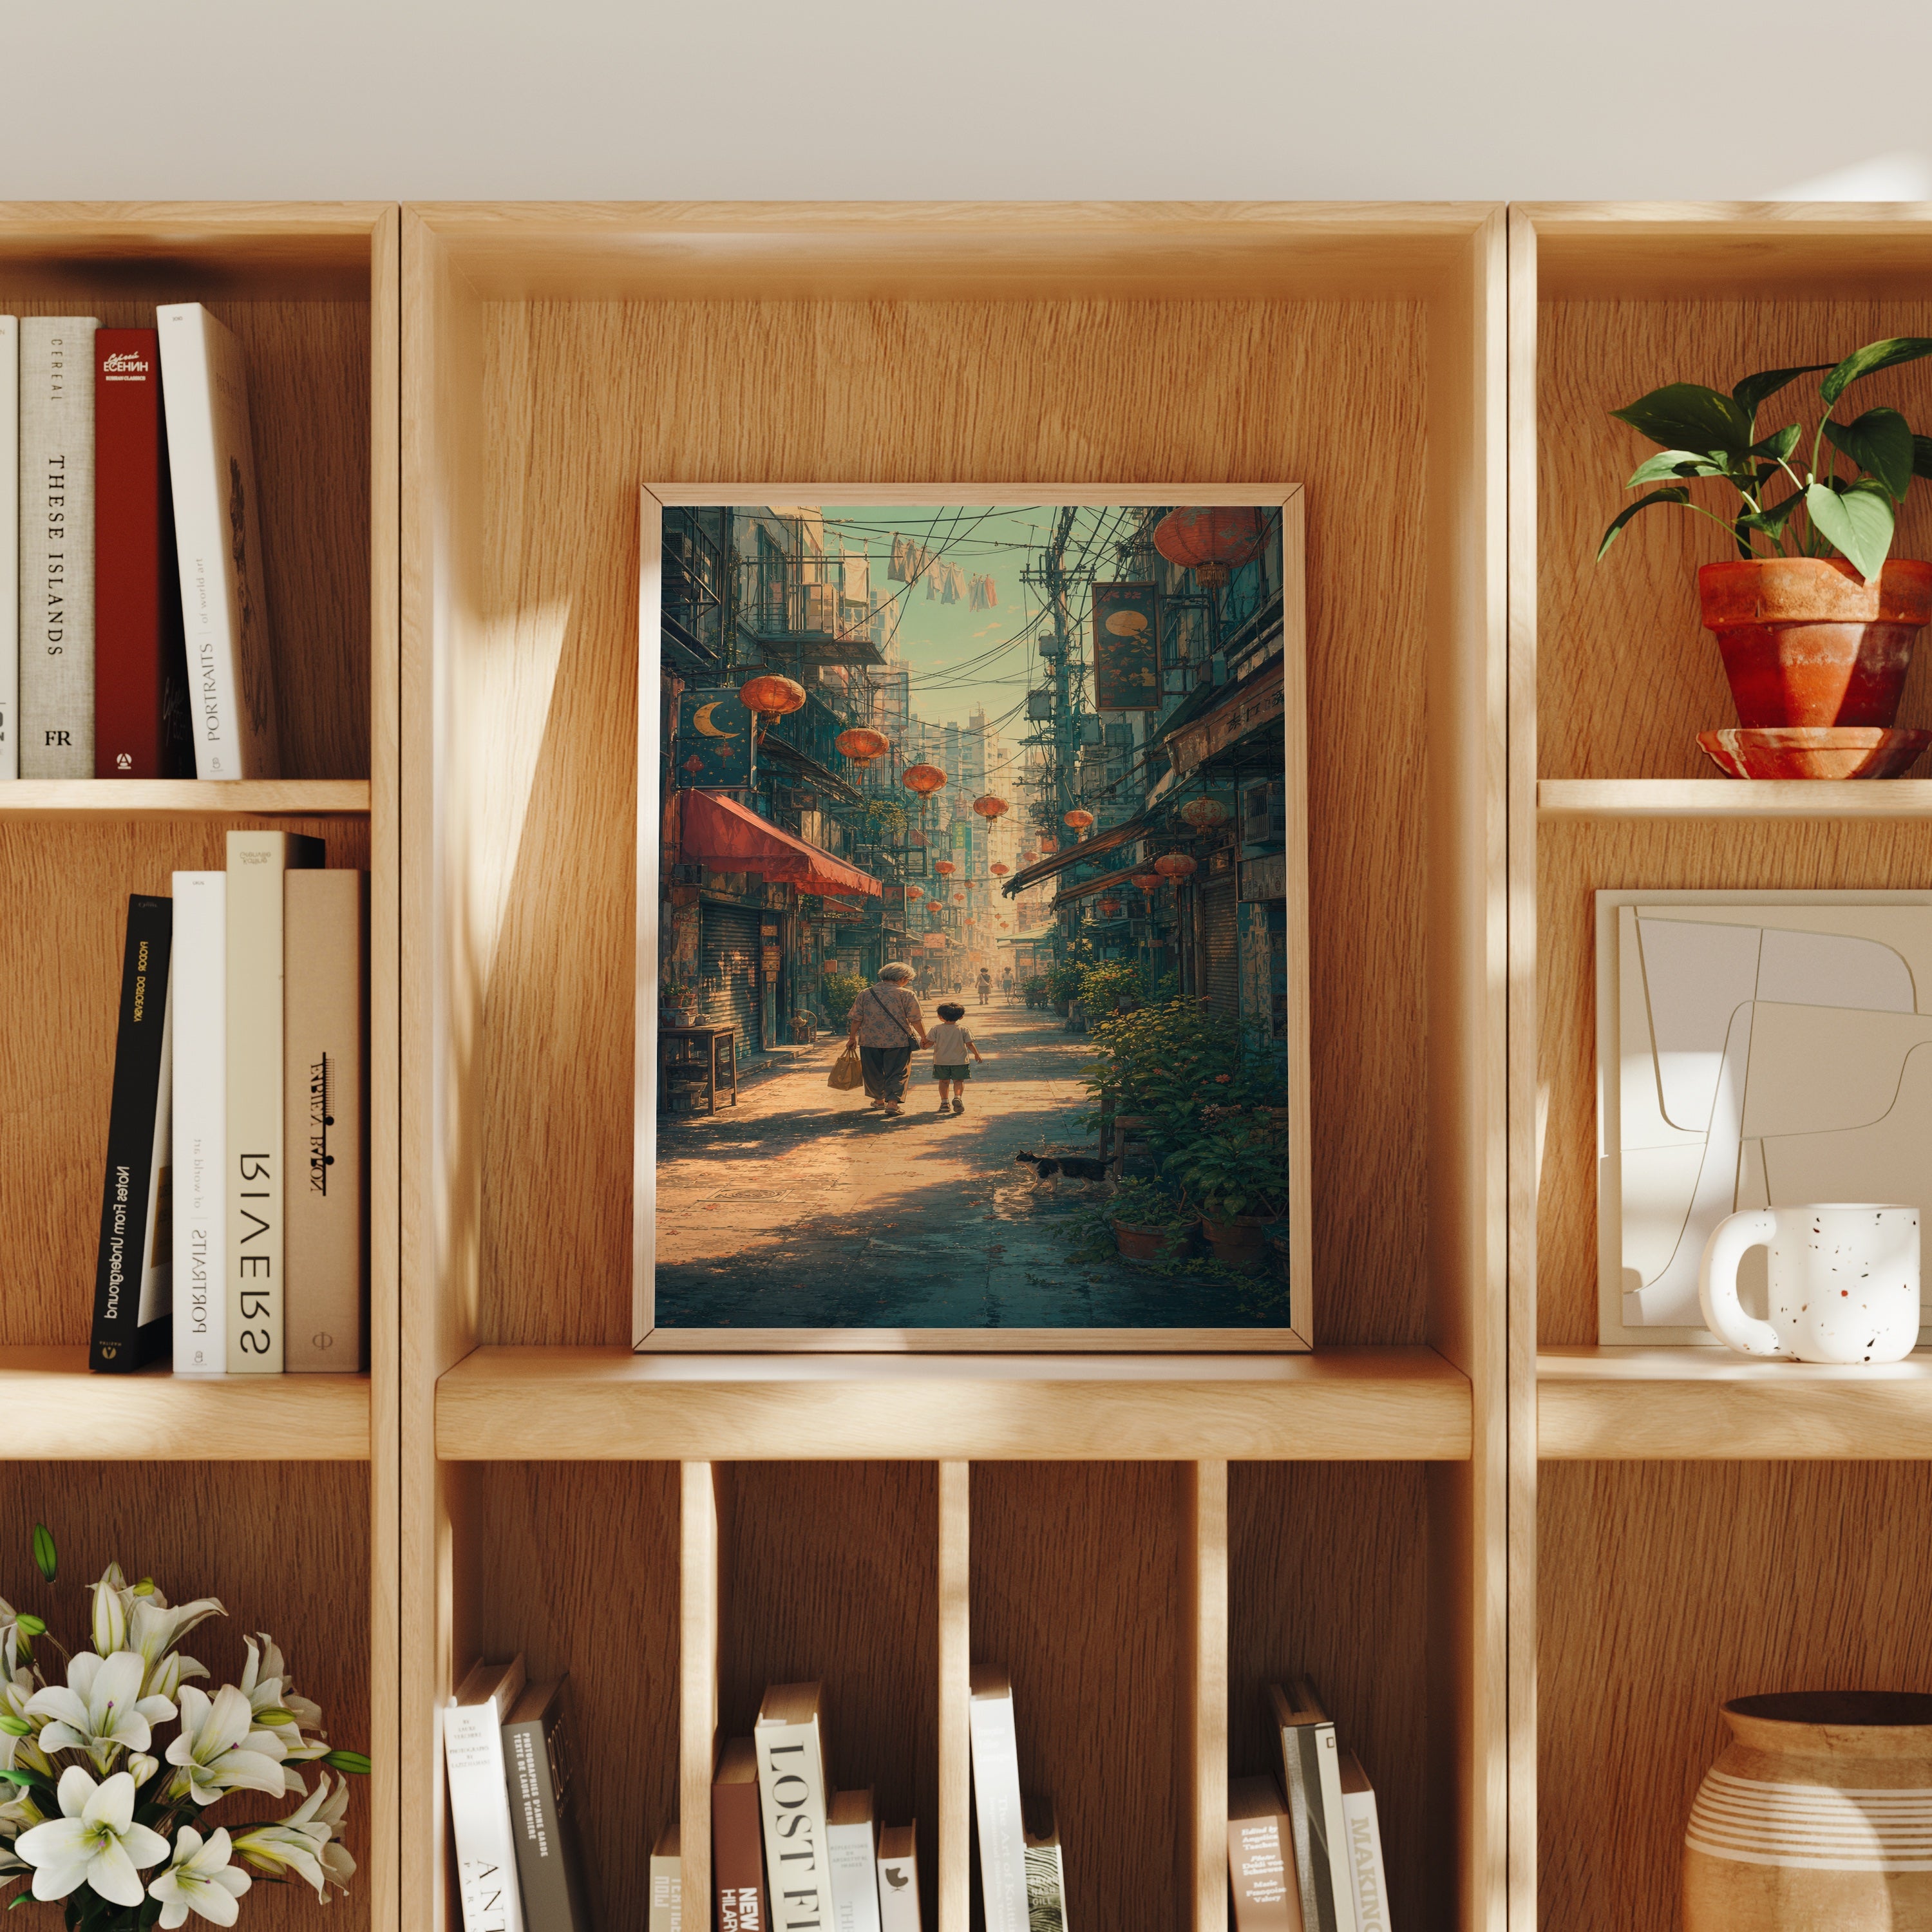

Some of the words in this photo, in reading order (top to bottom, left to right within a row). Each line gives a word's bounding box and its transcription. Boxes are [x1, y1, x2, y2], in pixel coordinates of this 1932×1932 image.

[51, 339, 62, 401] CEREAL
[104, 361, 148, 372] ЕСЕНИН
[48, 455, 64, 540] THESE
[196, 558, 205, 572] art
[48, 554, 64, 656] ISLANDS
[198, 578, 208, 611] world
[202, 613, 209, 623] of
[202, 643, 220, 741] PORTRAITS
[44, 731, 72, 746] FR
[514, 1734, 524, 1758] TEXTE
[518, 1761, 526, 1771] DE
[522, 1732, 539, 1797] PHOTOGRAPHIES
[520, 1774, 530, 1799] LAURE
[533, 1799, 544, 1828] D'ANNE
[769, 1741, 815, 1873] LOST
[999, 1795, 1008, 1826] The
[1004, 1862, 1013, 1880] of
[1242, 1827, 1267, 1835] Edited
[1242, 1834, 1278, 1842] Angelica
[538, 1832, 548, 1857] GARDE
[1242, 1842, 1278, 1850] Taschen
[739, 1888, 759, 1931] NEW
